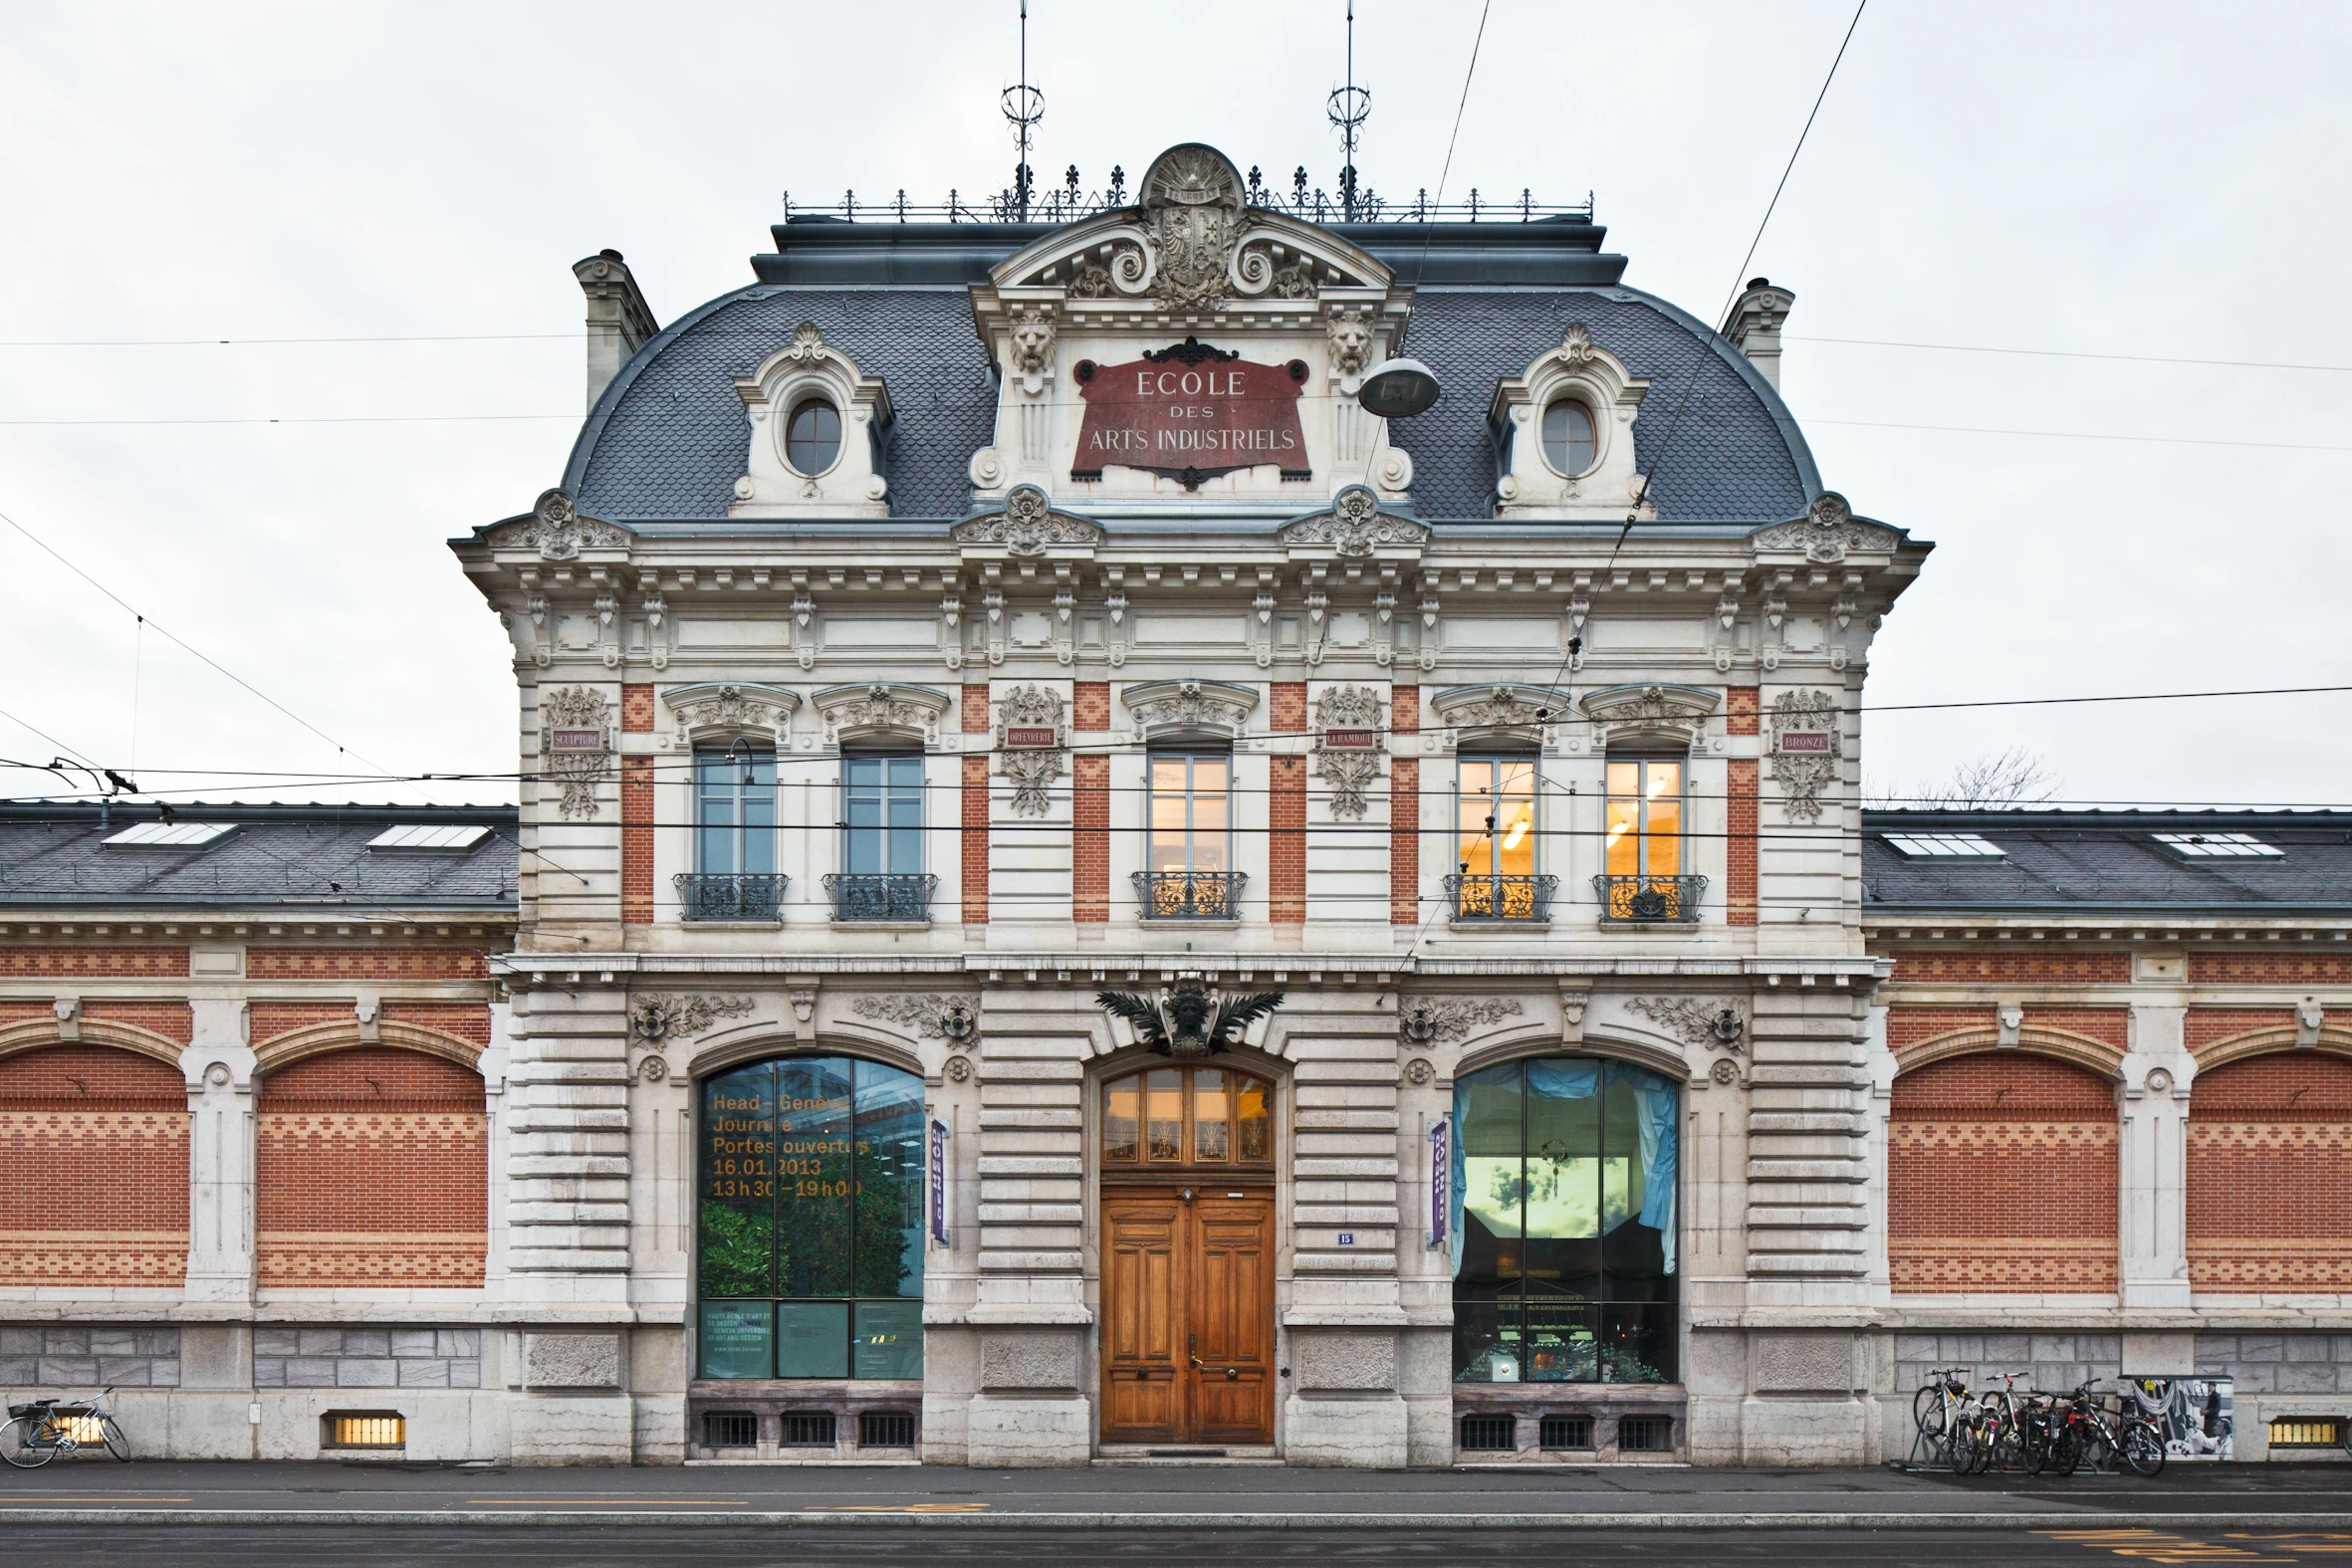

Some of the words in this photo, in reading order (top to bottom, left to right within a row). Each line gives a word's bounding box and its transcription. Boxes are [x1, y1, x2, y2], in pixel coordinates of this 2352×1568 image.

[1136, 371, 1245, 395] ECOLE
[1170, 406, 1214, 418] DES
[1089, 429, 1148, 450] ARTS
[1158, 429, 1295, 450] INDUSTRIELS
[555, 734, 598, 745] SCULPTURE
[1010, 732, 1053, 743] ORFEVRERIE
[1785, 737, 1825, 748] BRONZE
[713, 1094, 760, 1111] Head
[780, 1094, 847, 1111] Genève
[713, 1137, 774, 1154] Portes
[1341, 1234, 1350, 1243] 15
